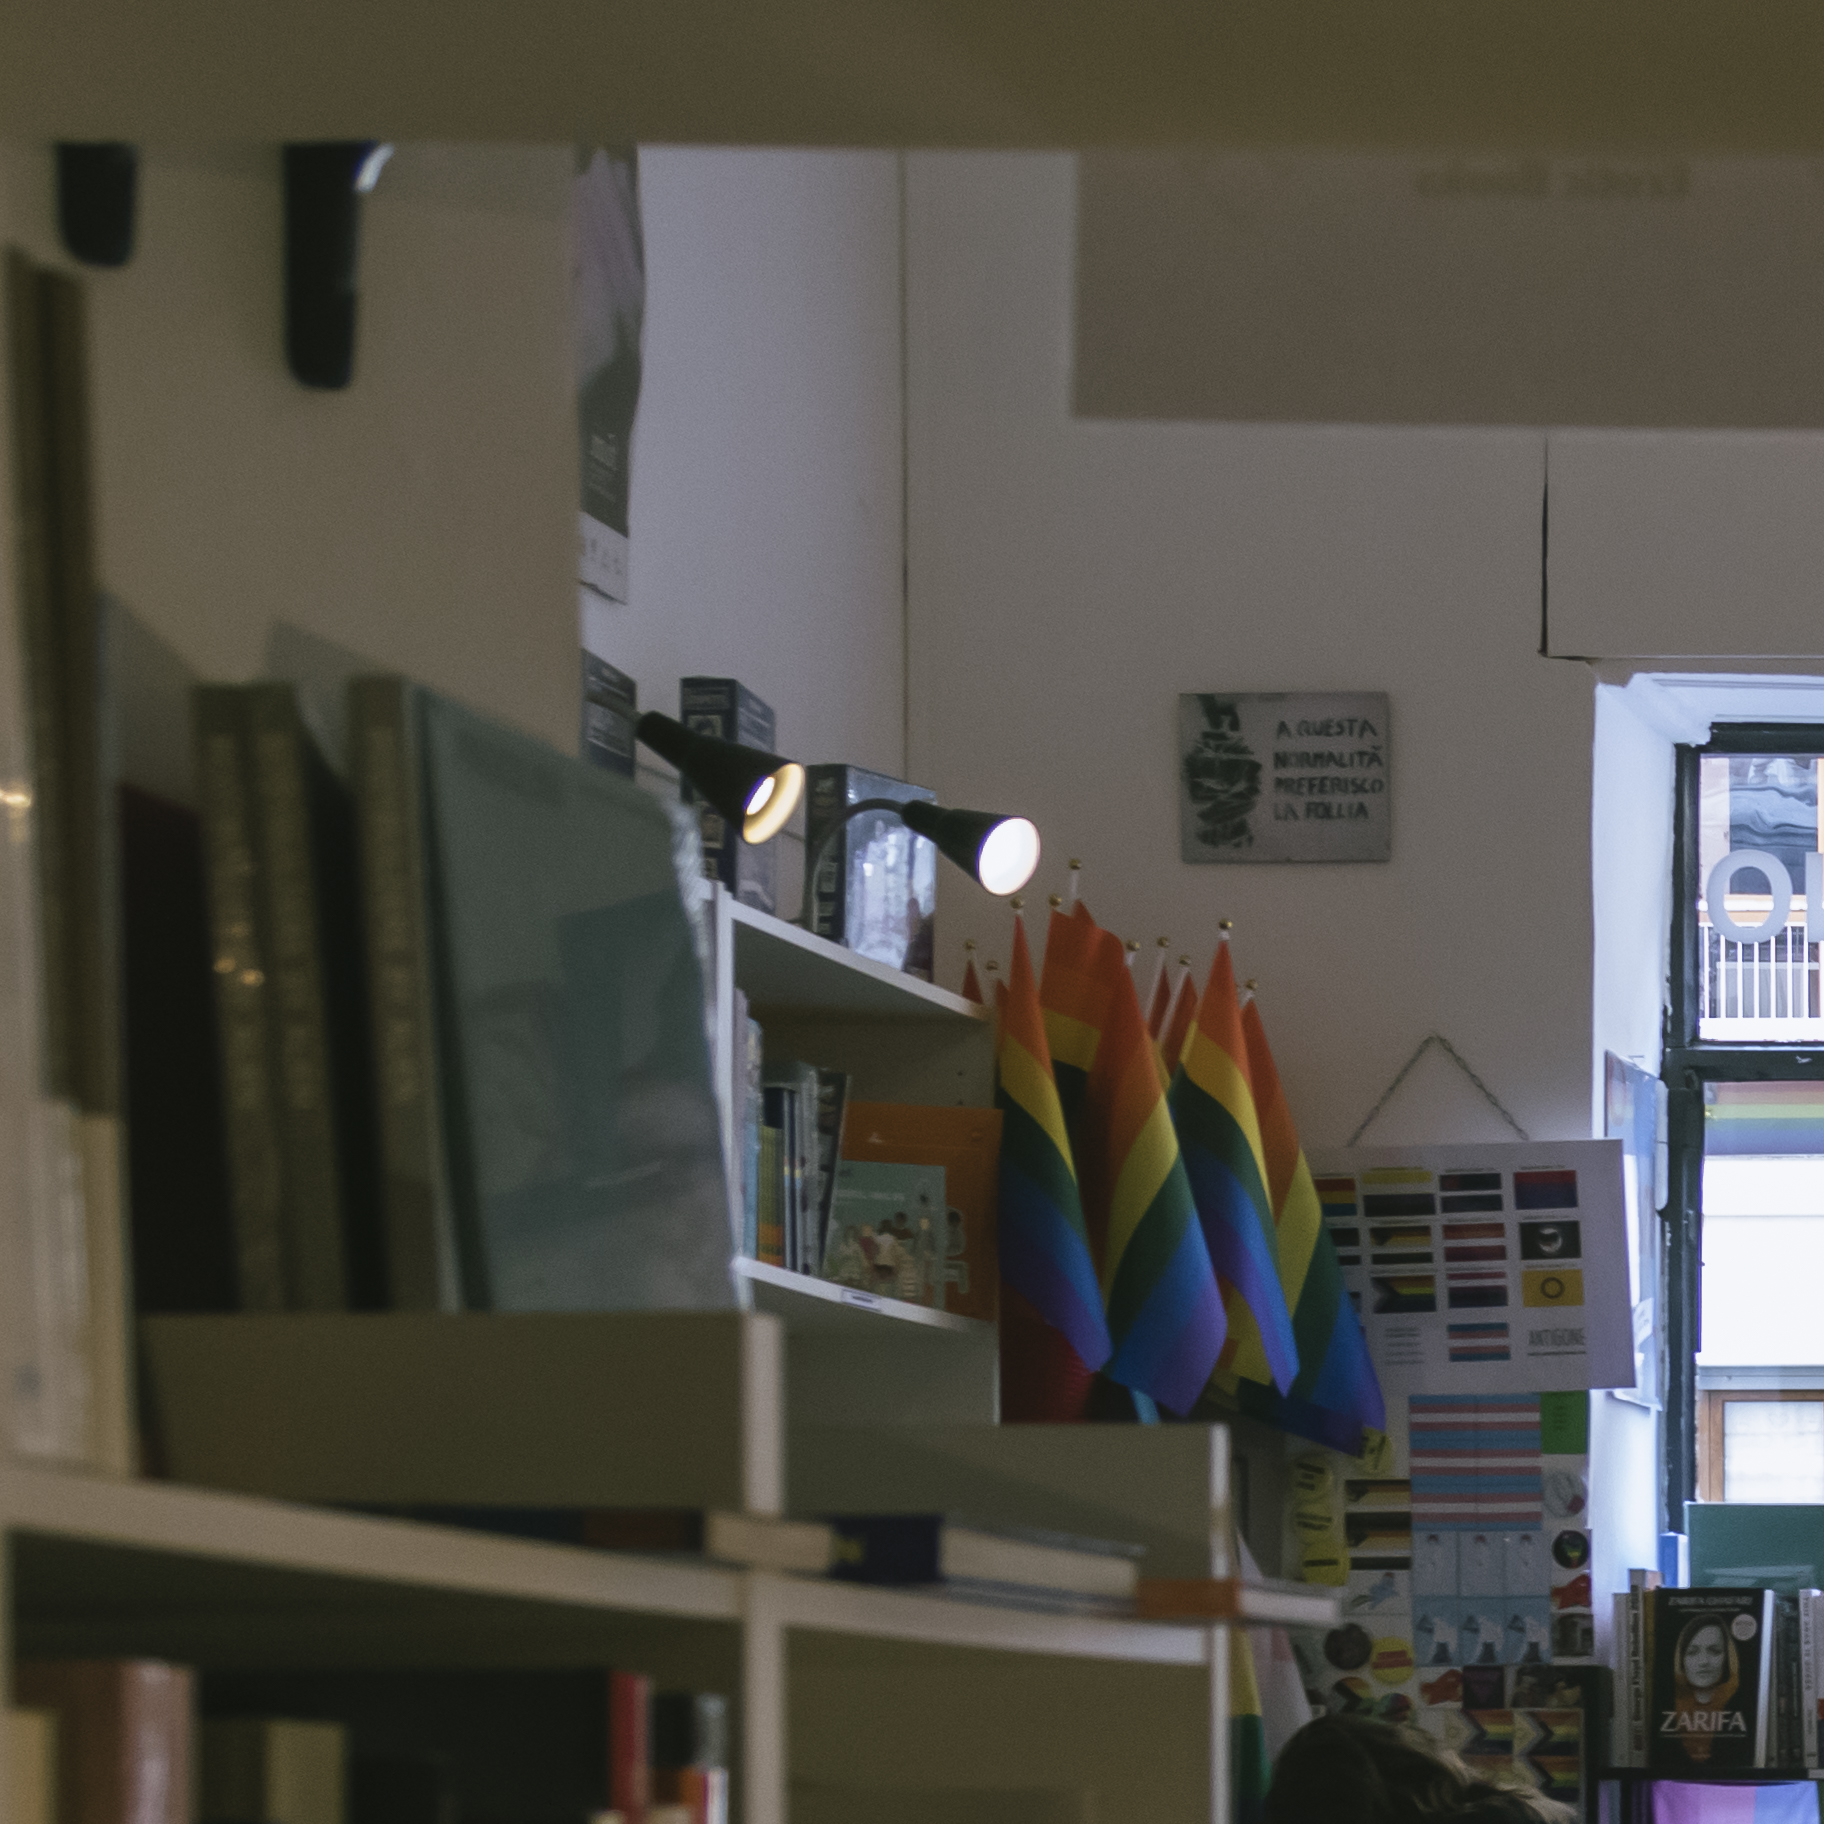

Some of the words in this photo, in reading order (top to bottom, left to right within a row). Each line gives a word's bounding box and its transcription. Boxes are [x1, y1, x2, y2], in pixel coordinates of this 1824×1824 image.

[1277, 720, 1293, 740] A
[1273, 776, 1386, 796] PREFERISCO
[1274, 802, 1299, 821] LA
[1304, 801, 1370, 820] FOLLIA
[1660, 1710, 1748, 1732] ZARIFA
